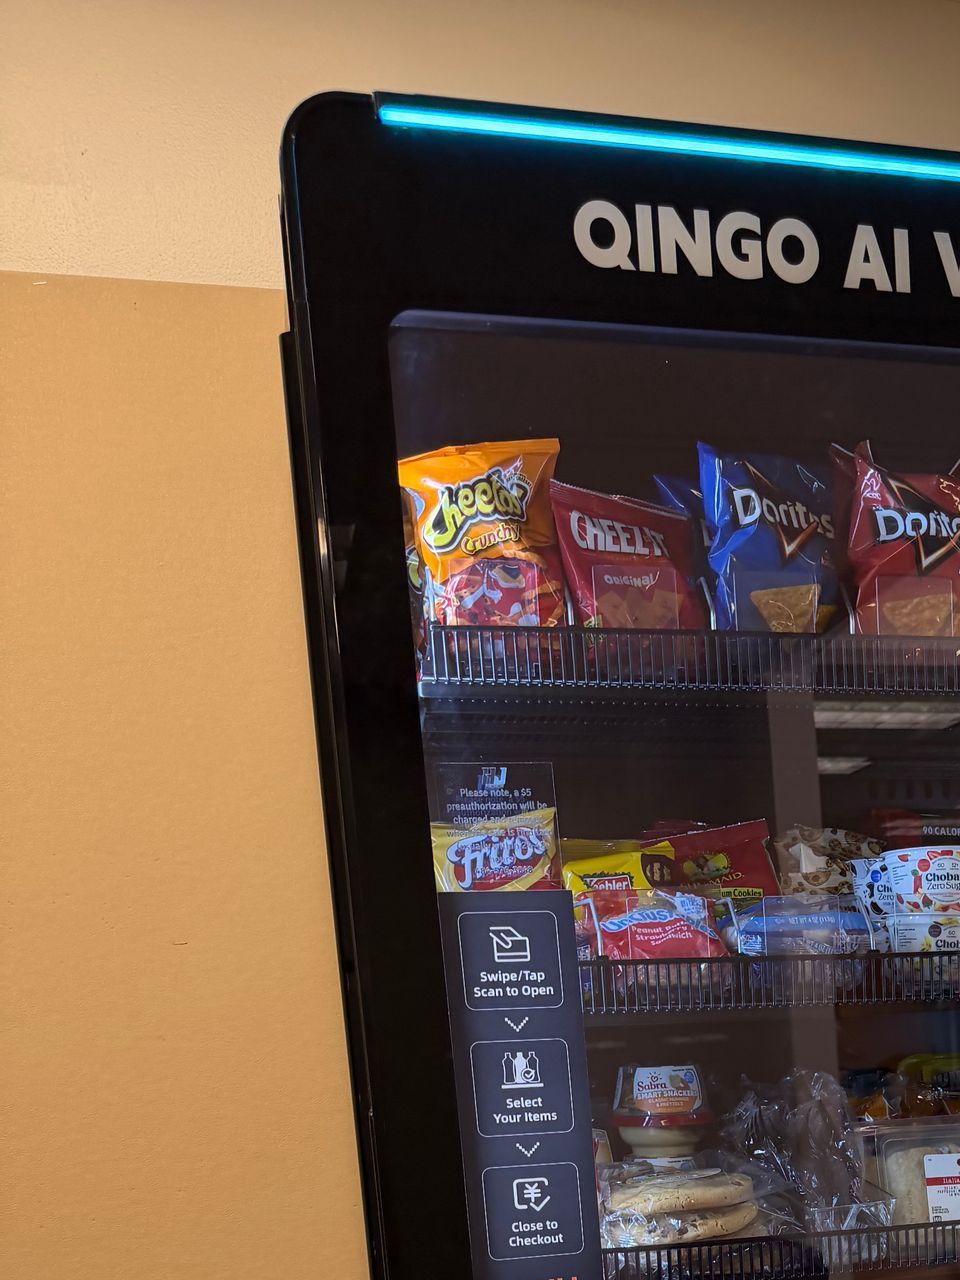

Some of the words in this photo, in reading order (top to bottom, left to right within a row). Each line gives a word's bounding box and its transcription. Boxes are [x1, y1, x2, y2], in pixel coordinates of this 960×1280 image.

[573, 200, 820, 284] QINGO
[843, 224, 911, 293] AI
[733, 488, 835, 539] Doritos
[461, 523, 521, 555] Crunchy
[460, 788, 488, 797] Please
[490, 789, 513, 798] note,
[521, 788, 532, 797] $5
[446, 801, 518, 812] preauthorization
[519, 801, 536, 810] will
[453, 815, 489, 825] charged
[922, 826, 933, 834] 90
[446, 827, 546, 890] Fritos
[926, 881, 946, 890] Zero
[738, 887, 763, 898] Cookies
[480, 970, 546, 984] Swipe/Tap
[473, 987, 504, 998] Scan
[505, 986, 519, 996] to
[521, 985, 554, 998] Open
[637, 1081, 668, 1092] Sabra
[506, 1096, 543, 1109] Select
[493, 1113, 522, 1124] Your
[524, 1111, 558, 1122] Items
[511, 1221, 544, 1232] Close
[546, 1220, 558, 1230] to
[508, 1233, 564, 1247] Checkout
